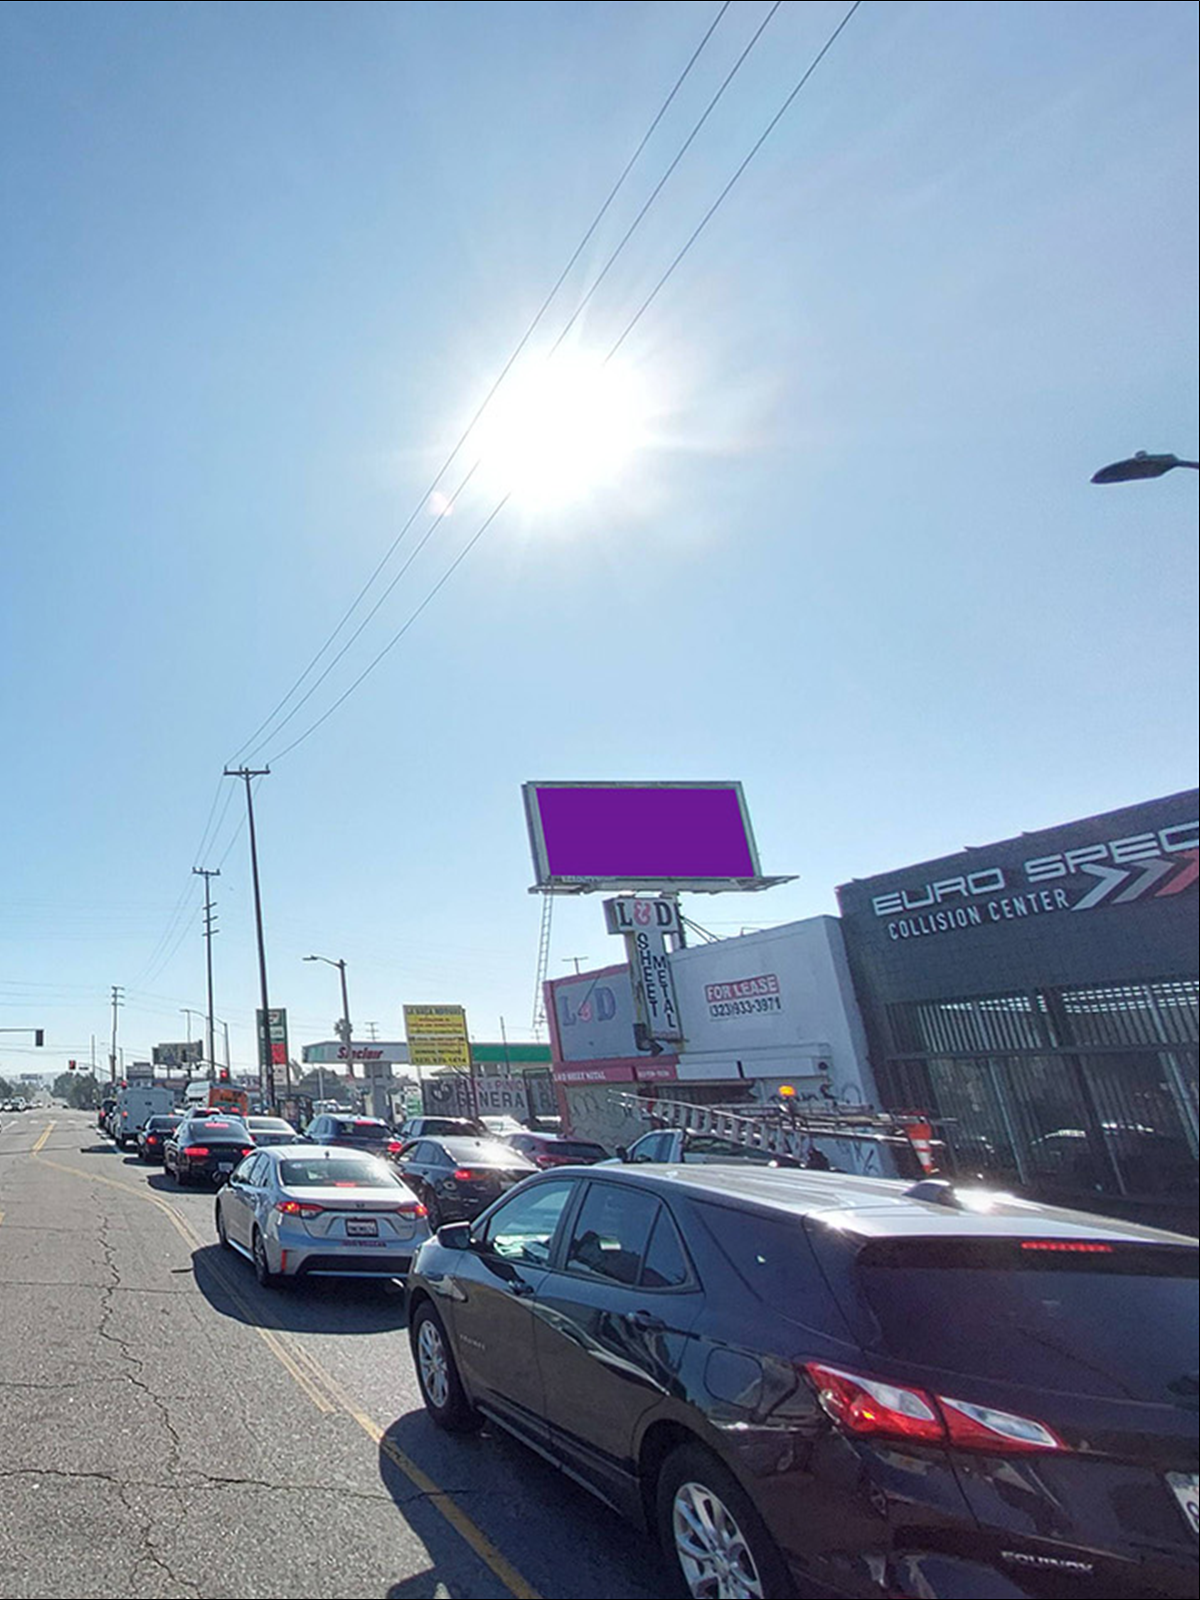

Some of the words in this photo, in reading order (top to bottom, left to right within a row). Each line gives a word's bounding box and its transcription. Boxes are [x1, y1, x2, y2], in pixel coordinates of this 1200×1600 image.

[616, 900, 673, 927] L&D
[871, 867, 1005, 917] EURO
[888, 904, 982, 941] COLLISION
[988, 888, 1070, 922] CENTER
[637, 932, 658, 1018] SHEET
[652, 956, 676, 1028] METAL
[707, 985, 732, 1001] FOR
[733, 976, 777, 997] LEASE
